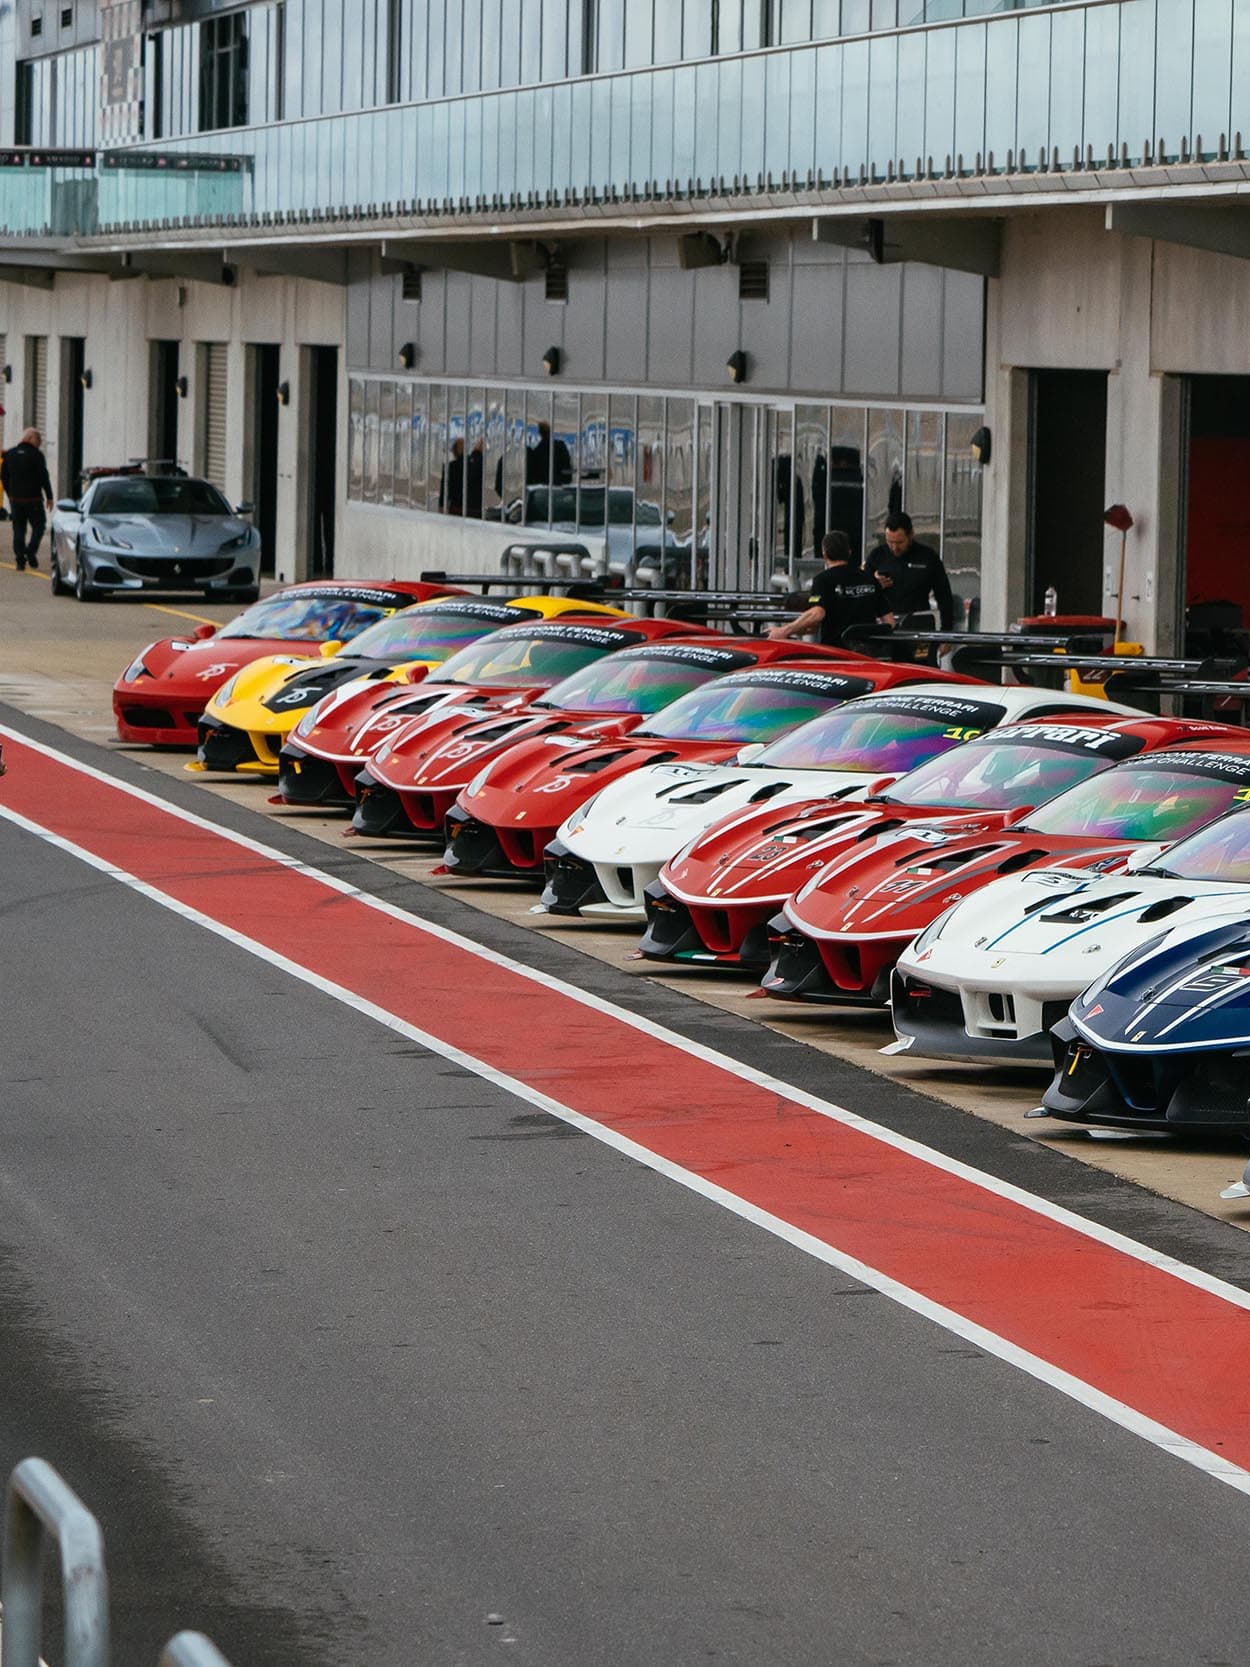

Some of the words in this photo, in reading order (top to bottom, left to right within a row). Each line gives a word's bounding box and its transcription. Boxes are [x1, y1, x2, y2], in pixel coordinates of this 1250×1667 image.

[786, 671, 849, 686] FERRARI
[916, 696, 980, 713] FERRARI
[1156, 758, 1250, 776] CHALLENGE
